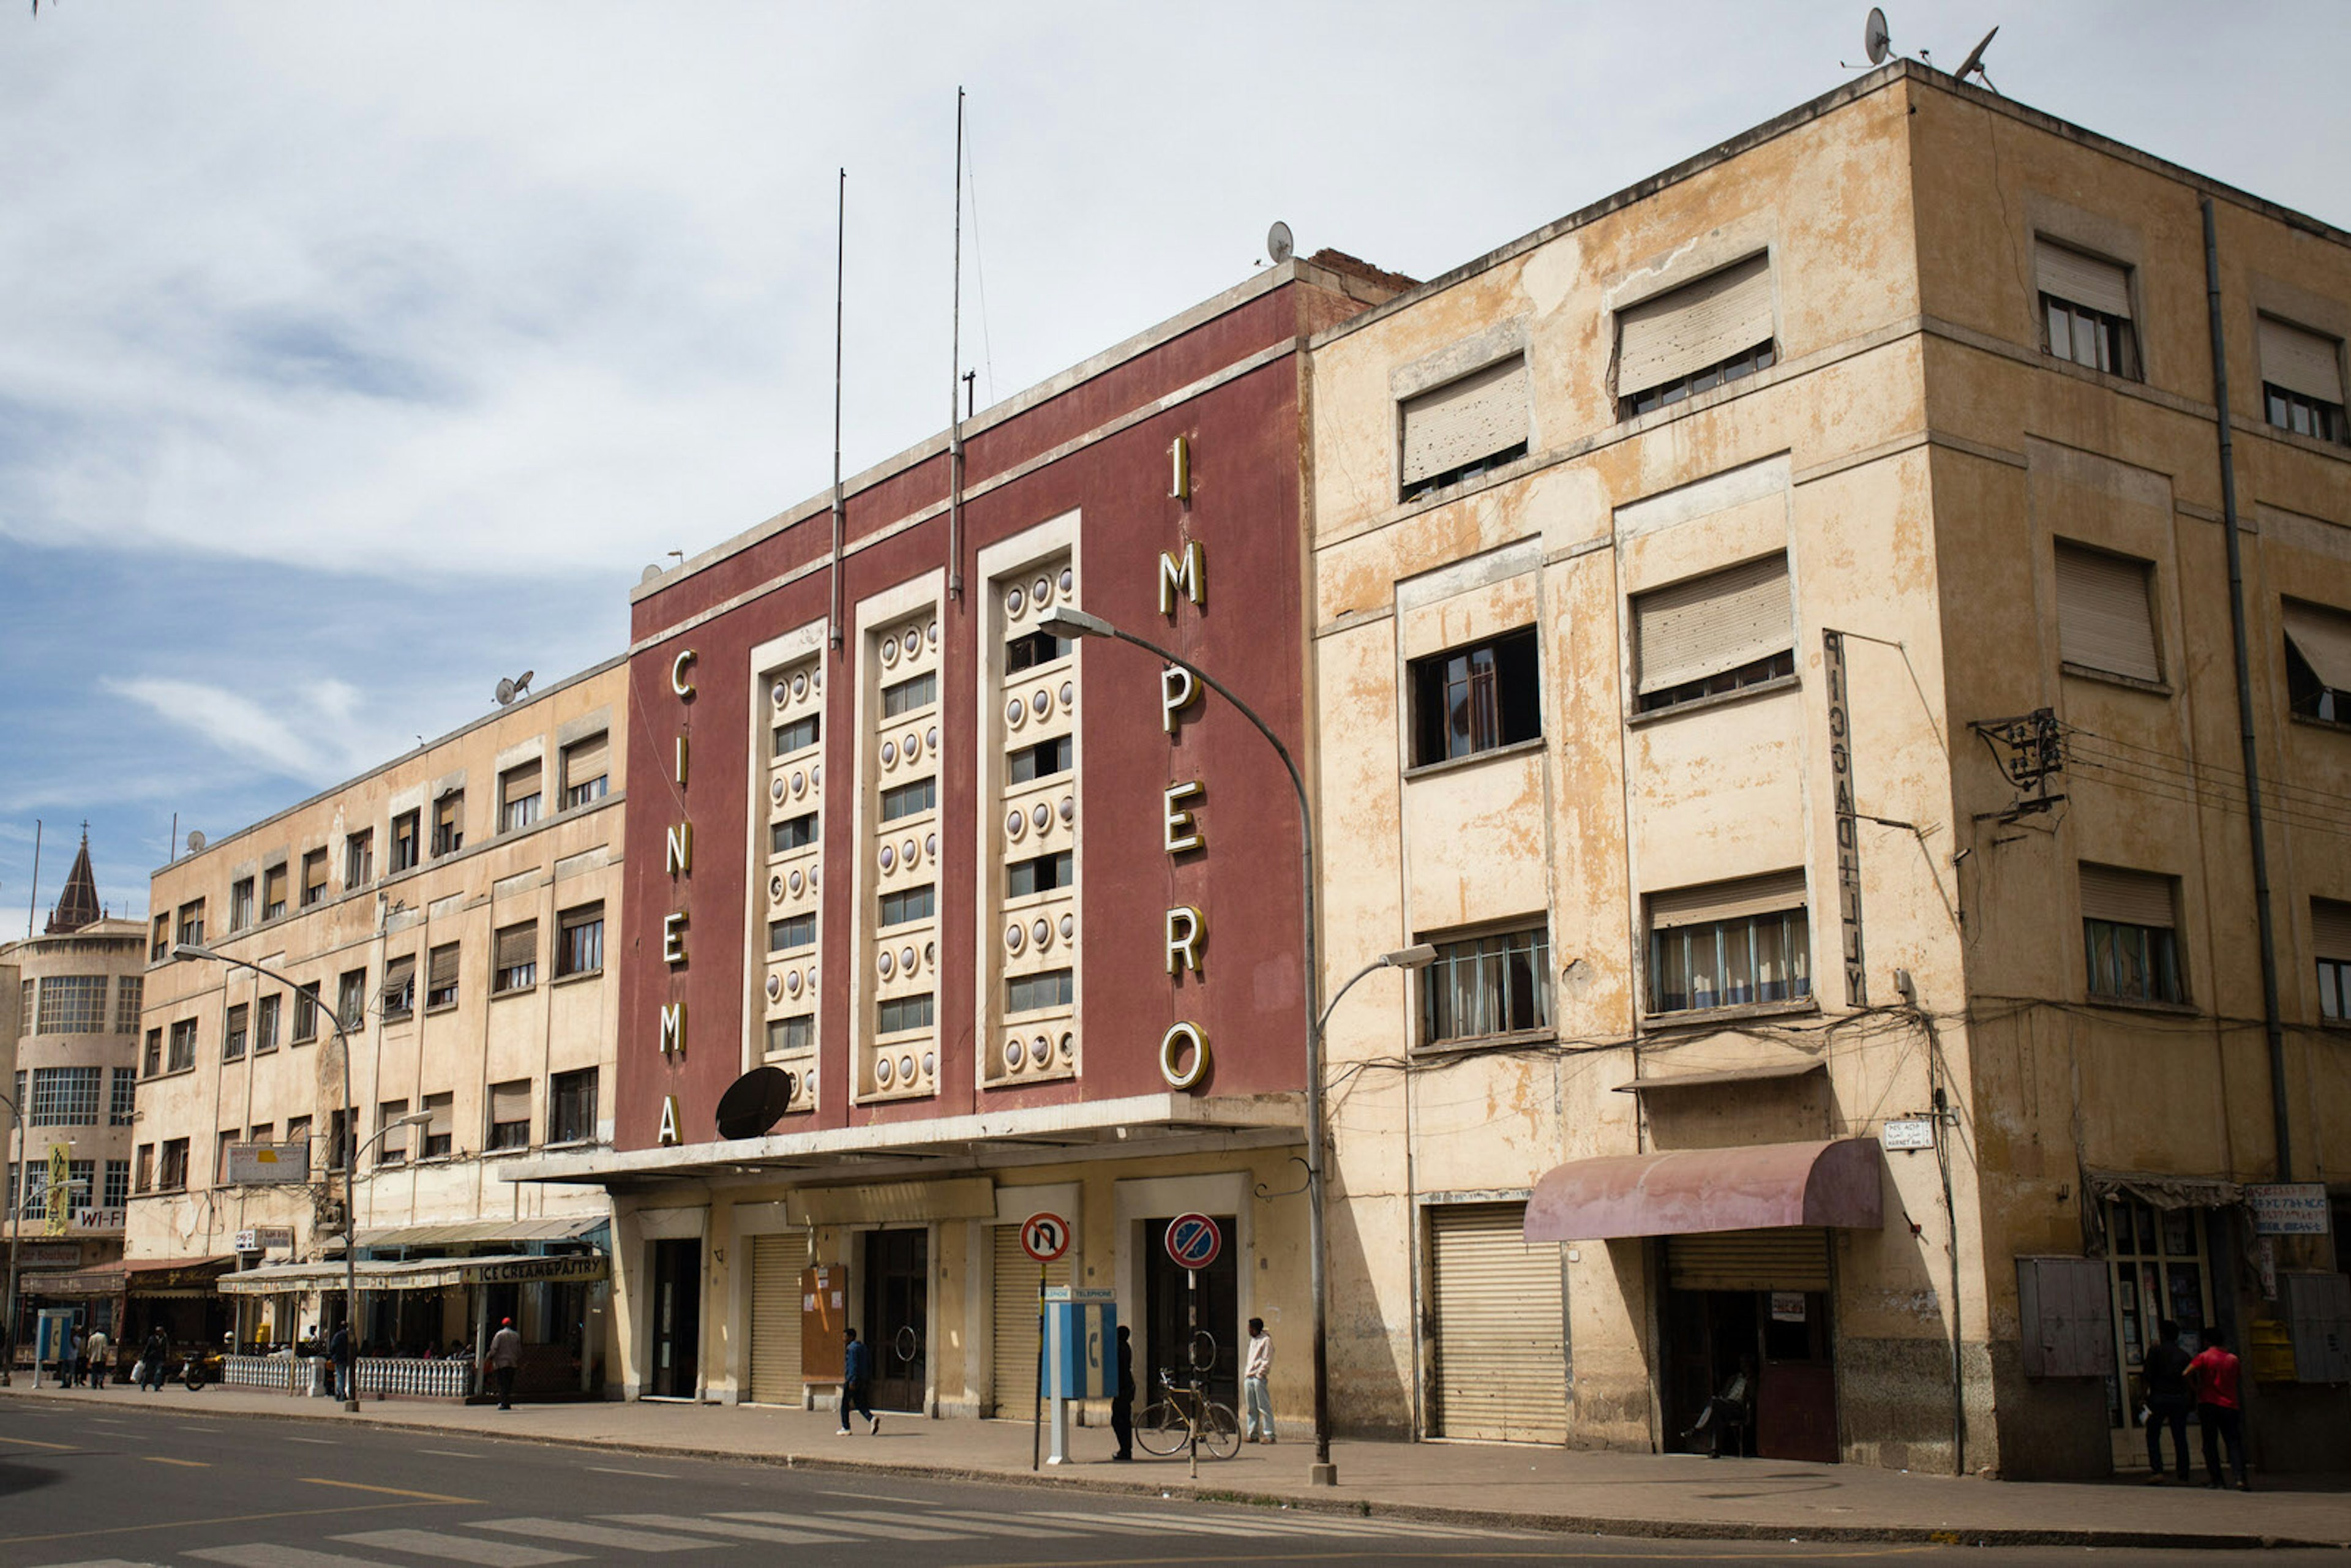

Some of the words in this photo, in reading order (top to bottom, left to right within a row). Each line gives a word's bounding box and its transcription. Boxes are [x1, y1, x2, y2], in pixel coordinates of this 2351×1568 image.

[658, 649, 697, 1146] CINEMA
[1158, 435, 1210, 1090] IMPERO
[479, 1267, 499, 1281] ICE
